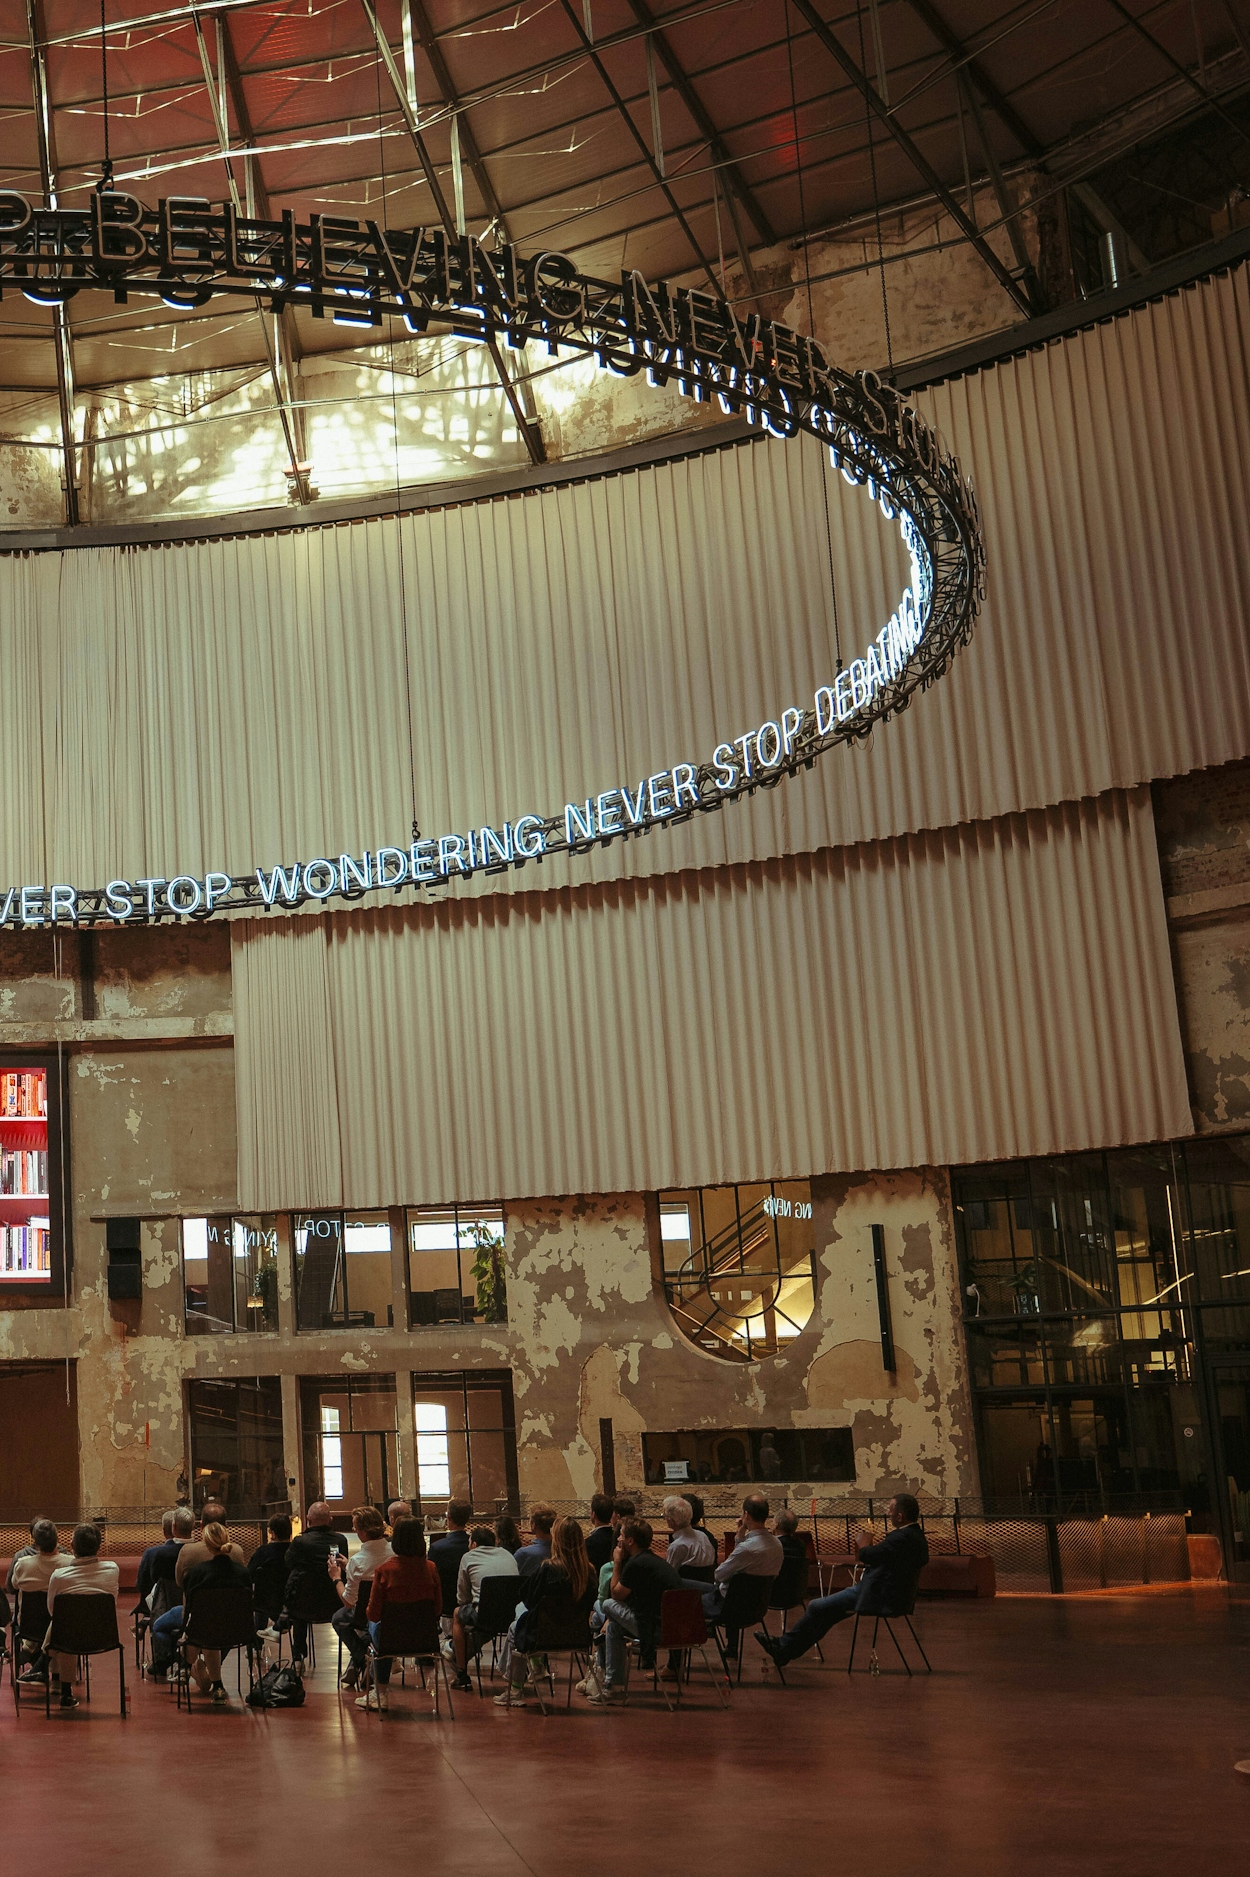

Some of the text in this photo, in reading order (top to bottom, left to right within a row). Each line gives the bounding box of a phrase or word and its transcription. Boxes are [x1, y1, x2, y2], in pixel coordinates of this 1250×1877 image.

[92, 190, 586, 326] BELIEVING
[623, 268, 838, 396] NEVER
[105, 873, 233, 920] STOP
[255, 813, 547, 907] WONDERING
[562, 762, 701, 844] NEVER
[711, 706, 804, 791] STOP
[813, 587, 916, 736] DEBATING
